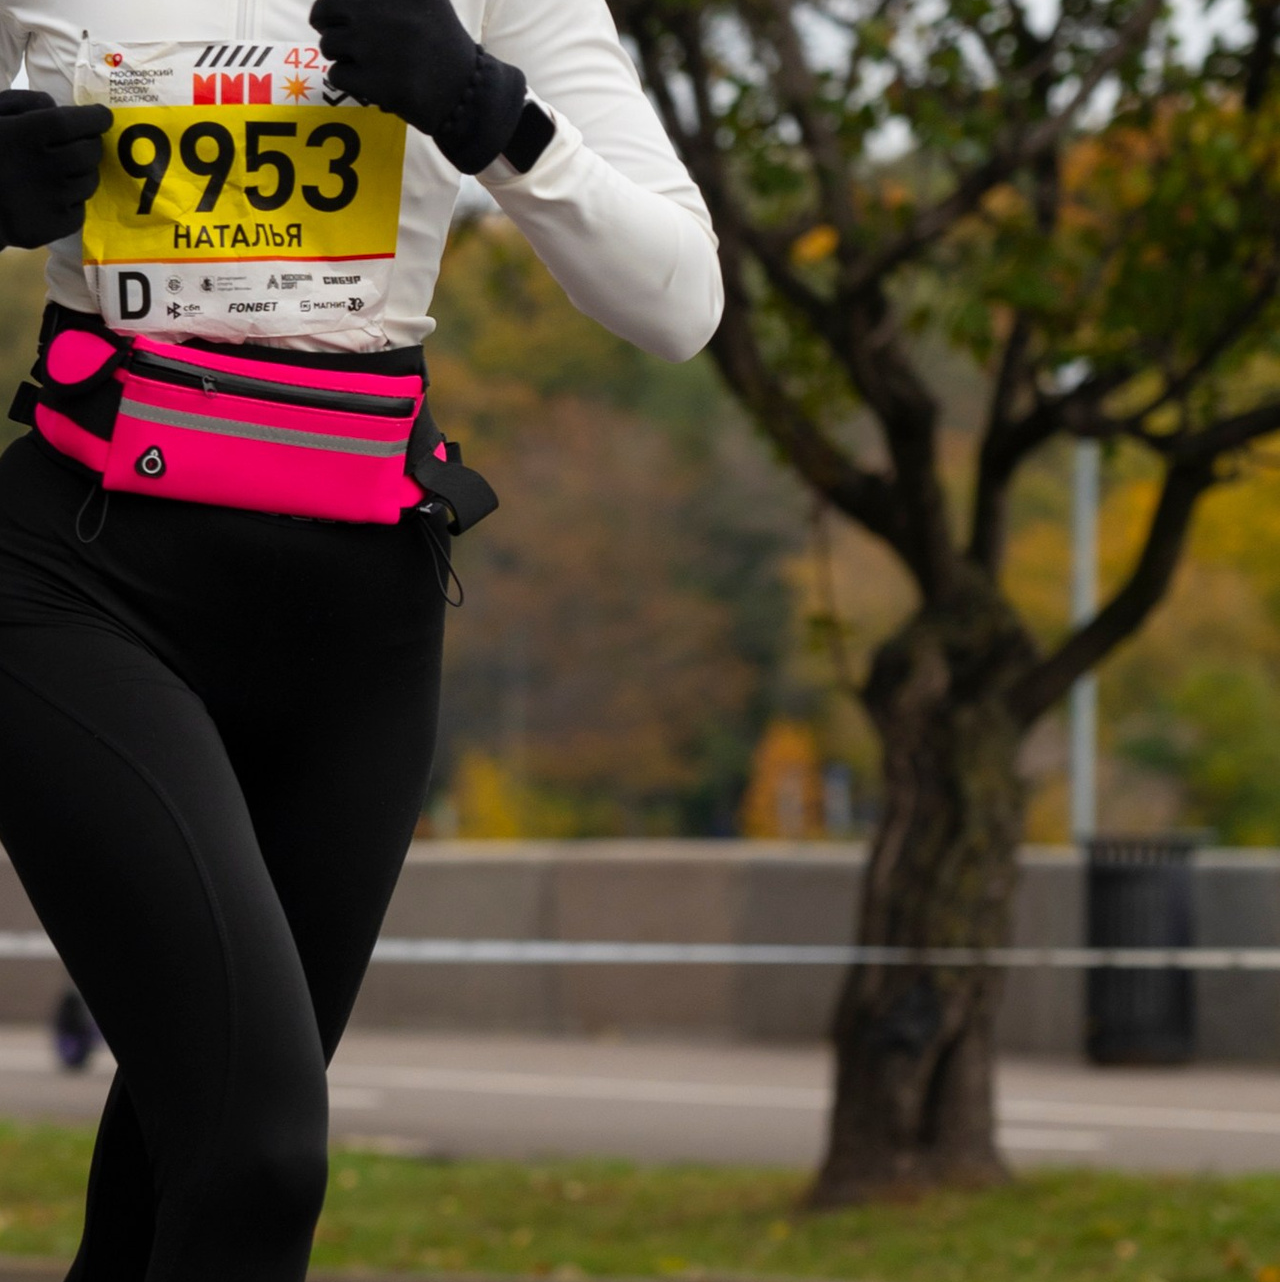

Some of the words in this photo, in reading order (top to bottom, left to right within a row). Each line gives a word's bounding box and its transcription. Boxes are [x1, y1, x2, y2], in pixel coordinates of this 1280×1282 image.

[284, 48, 328, 73] 42,
[109, 78, 155, 86] МАРАФОН
[109, 95, 159, 103] MARATHON
[117, 121, 362, 215] 9953
[173, 223, 303, 249] НАТАЛЬЯ
[118, 271, 151, 320] D
[228, 302, 278, 313] FONBET
[314, 301, 346, 309] МАГНИТ
